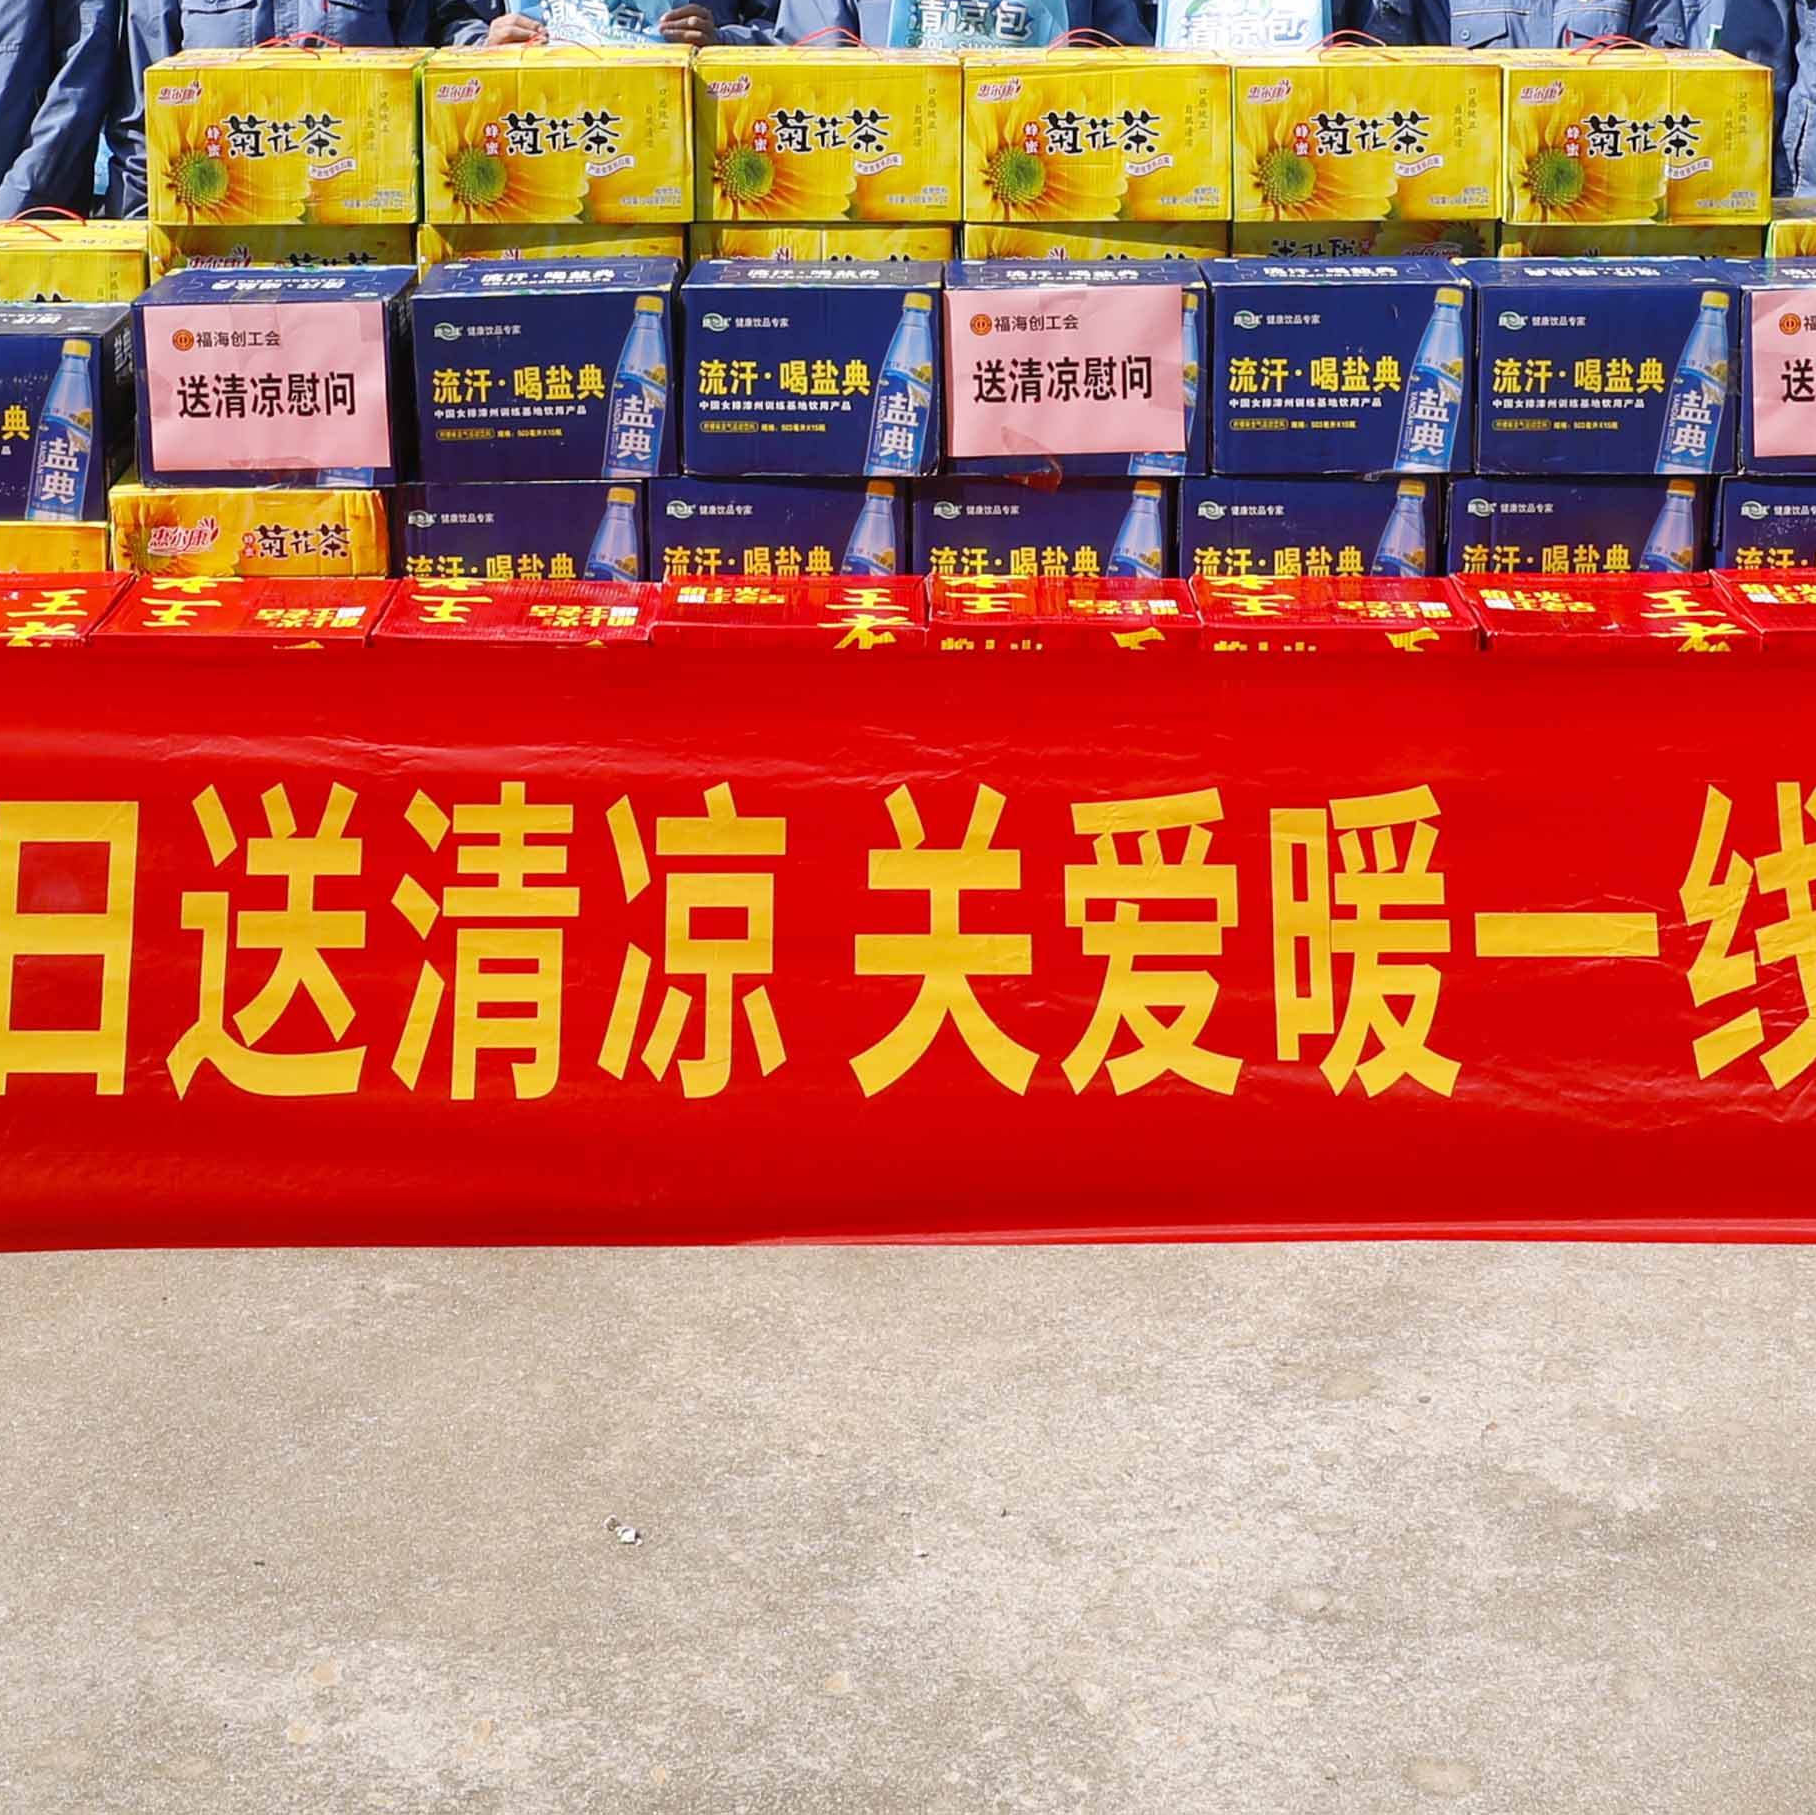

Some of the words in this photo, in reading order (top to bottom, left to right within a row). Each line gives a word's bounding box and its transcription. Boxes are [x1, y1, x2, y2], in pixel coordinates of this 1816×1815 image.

[223, 114, 342, 157] 菊花茶
[502, 112, 620, 155] 菊花茶
[771, 110, 890, 153] 菊花茶
[1042, 111, 1160, 154] 菊花茶
[1311, 111, 1430, 154] 菊花茶
[1583, 114, 1701, 157] 菊花茶
[195, 329, 282, 348] 福海创工会
[466, 324, 522, 336] 健康饮品专家
[734, 317, 790, 329] 健康饮品专家
[994, 313, 1080, 333] 福海创工会
[1266, 314, 1322, 326] 健康饮品专家
[1531, 315, 1587, 327] 健康饮品专家
[432, 363, 606, 404] 流汗·喝盐典
[697, 359, 872, 396] 流汗·喝盐典
[972, 354, 1154, 404] 送清凉慰问
[1228, 355, 1402, 393] 流汗·喝盐典
[1492, 357, 1667, 395] 流汗·喝盐典
[177, 371, 357, 419] 送清凉慰问
[616, 394, 656, 462] 盐典
[879, 392, 919, 461] 盐典
[1409, 387, 1451, 457] 盐典
[1671, 389, 1713, 458] 盐典
[40, 437, 80, 504] 盐典
[440, 512, 495, 524] 健康饮品专家
[698, 503, 754, 516] 健康饮品专家
[965, 504, 1020, 516] 健康饮品专家
[1230, 504, 1285, 517] 健康饮品专家
[1500, 502, 1555, 514] 健康饮品专家
[148, 526, 218, 549] 惠尔康
[254, 523, 351, 559] 菊花茶
